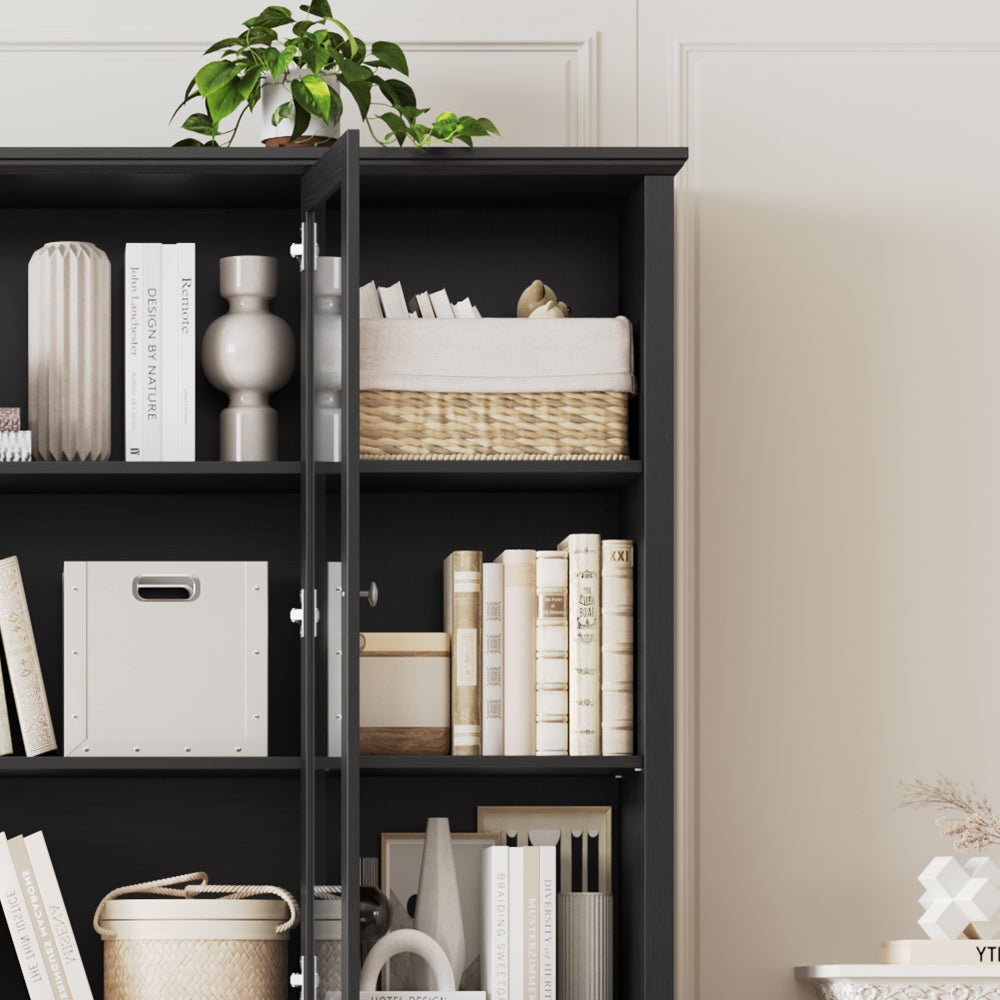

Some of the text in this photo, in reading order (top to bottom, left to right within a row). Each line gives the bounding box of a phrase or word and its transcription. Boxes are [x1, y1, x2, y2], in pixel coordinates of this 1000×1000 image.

[130, 266, 140, 357] John Lanchester
[181, 277, 192, 334] Remote
[147, 288, 157, 420] DESIGN BY NATURE
[609, 550, 629, 562] XXI
[497, 873, 506, 937] BRAIDING
[544, 879, 552, 943] DIVERSITY
[976, 946, 1000, 962] YT
